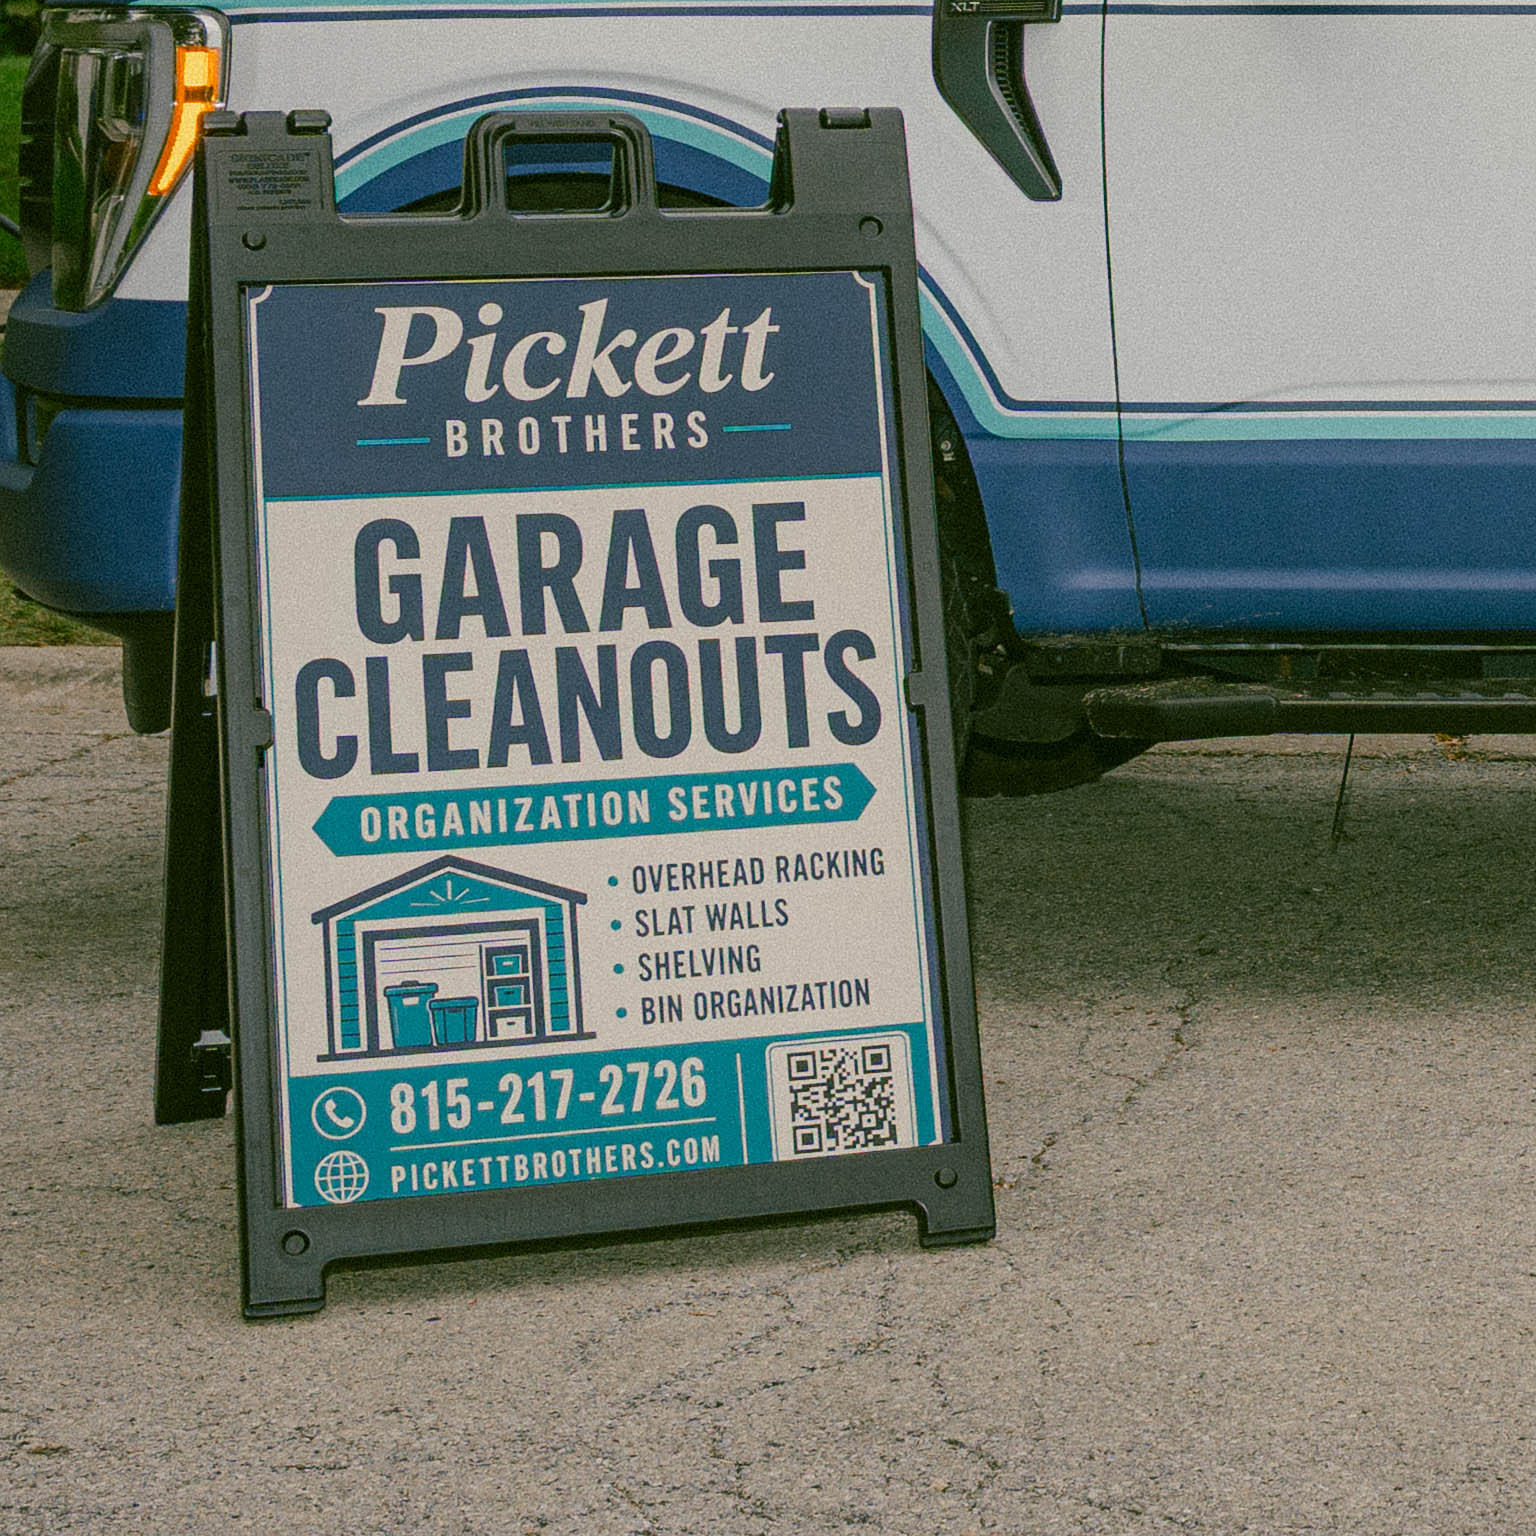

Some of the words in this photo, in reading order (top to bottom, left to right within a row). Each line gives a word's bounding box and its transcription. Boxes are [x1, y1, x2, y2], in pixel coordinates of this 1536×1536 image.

[952, 2, 980, 12] XLT
[357, 298, 780, 407] Pickett
[446, 411, 710, 458] BROTHERS
[354, 502, 815, 645] GARAGE
[296, 629, 882, 779] CLEANOUTS
[360, 791, 651, 843] ORGANIZATION
[669, 776, 845, 823] SERVICES
[632, 858, 765, 895] OVERHEAD
[775, 848, 885, 883] RACKING
[635, 905, 695, 937] SLAT
[706, 898, 789, 931] WALLS
[638, 945, 762, 982] SHELVING
[641, 995, 684, 1025] BIN
[694, 978, 871, 1023] ORGANIZATION
[391, 1056, 706, 1135] 815-217-2726
[391, 1135, 720, 1193] PICKETTBROTHERS.COM
